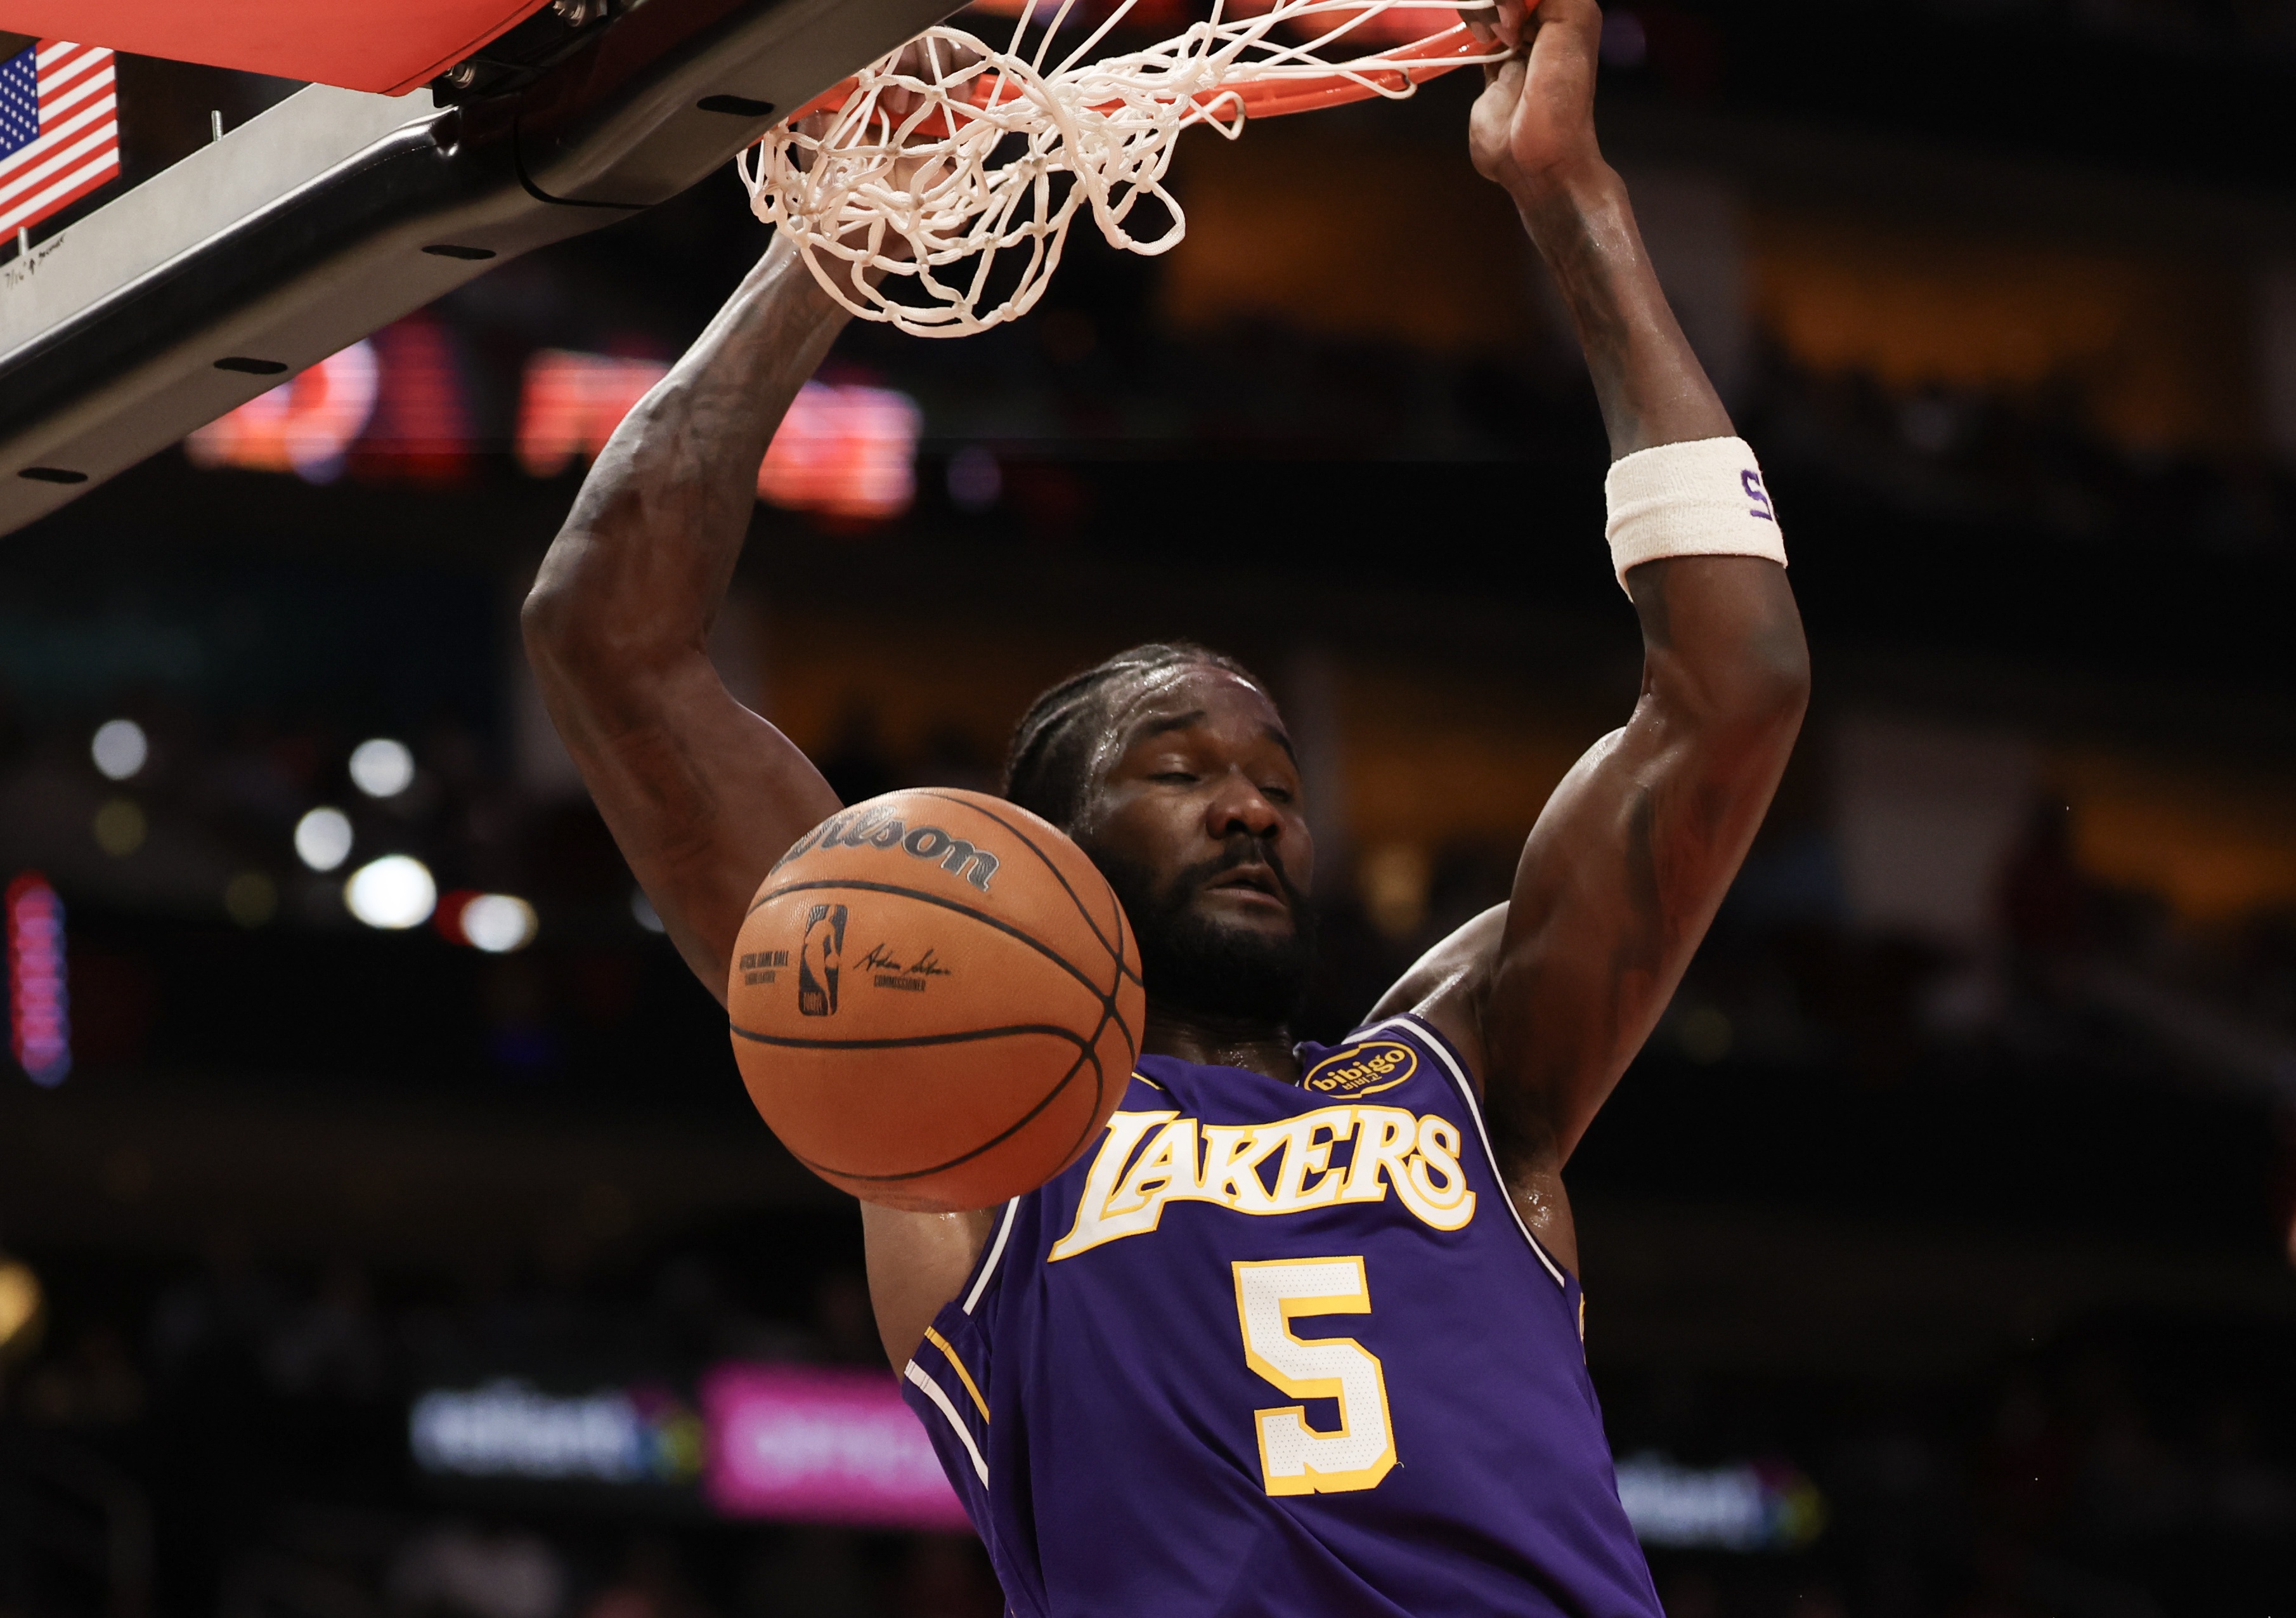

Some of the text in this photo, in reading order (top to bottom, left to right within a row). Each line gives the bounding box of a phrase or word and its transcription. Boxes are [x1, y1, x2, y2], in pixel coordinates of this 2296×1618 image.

[1312, 1050, 1406, 1092] bibigo
[1046, 1104, 1476, 1263] LAKERS
[1231, 1255, 1398, 1496] 5
